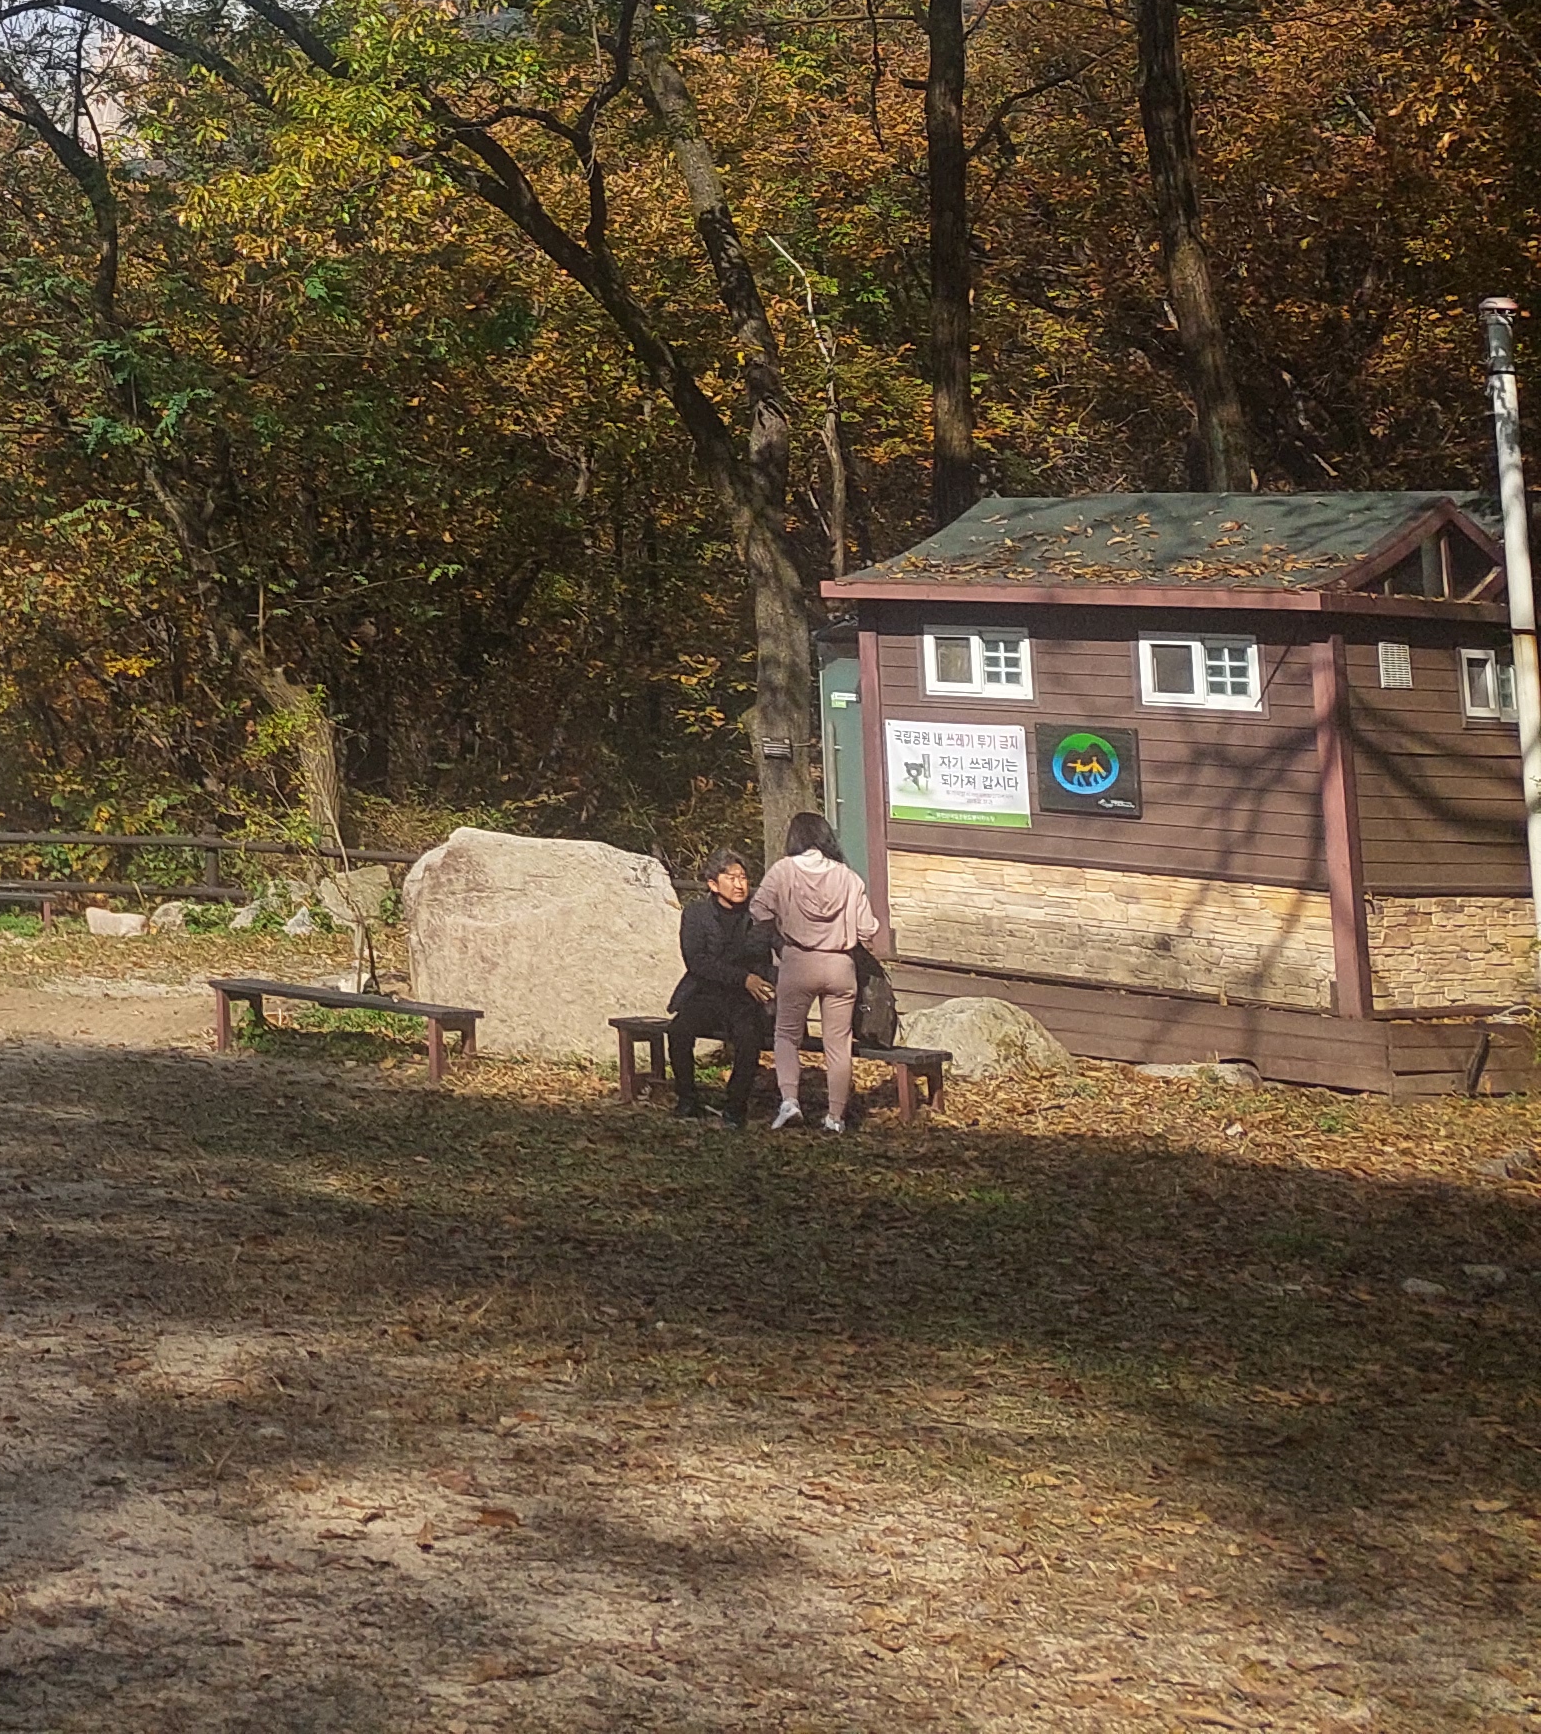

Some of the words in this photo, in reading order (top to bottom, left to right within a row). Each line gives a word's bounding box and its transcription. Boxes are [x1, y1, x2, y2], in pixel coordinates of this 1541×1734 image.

[893, 729, 931, 746] 국립공원
[933, 732, 943, 747] 내
[946, 733, 974, 748] 쓰레기
[977, 734, 996, 750] 투기
[999, 735, 1019, 750] 금지
[939, 755, 964, 770] 자기
[968, 757, 1019, 773] 쓰레기는
[940, 773, 977, 789] 되가져
[981, 775, 1019, 791] 갑시다
